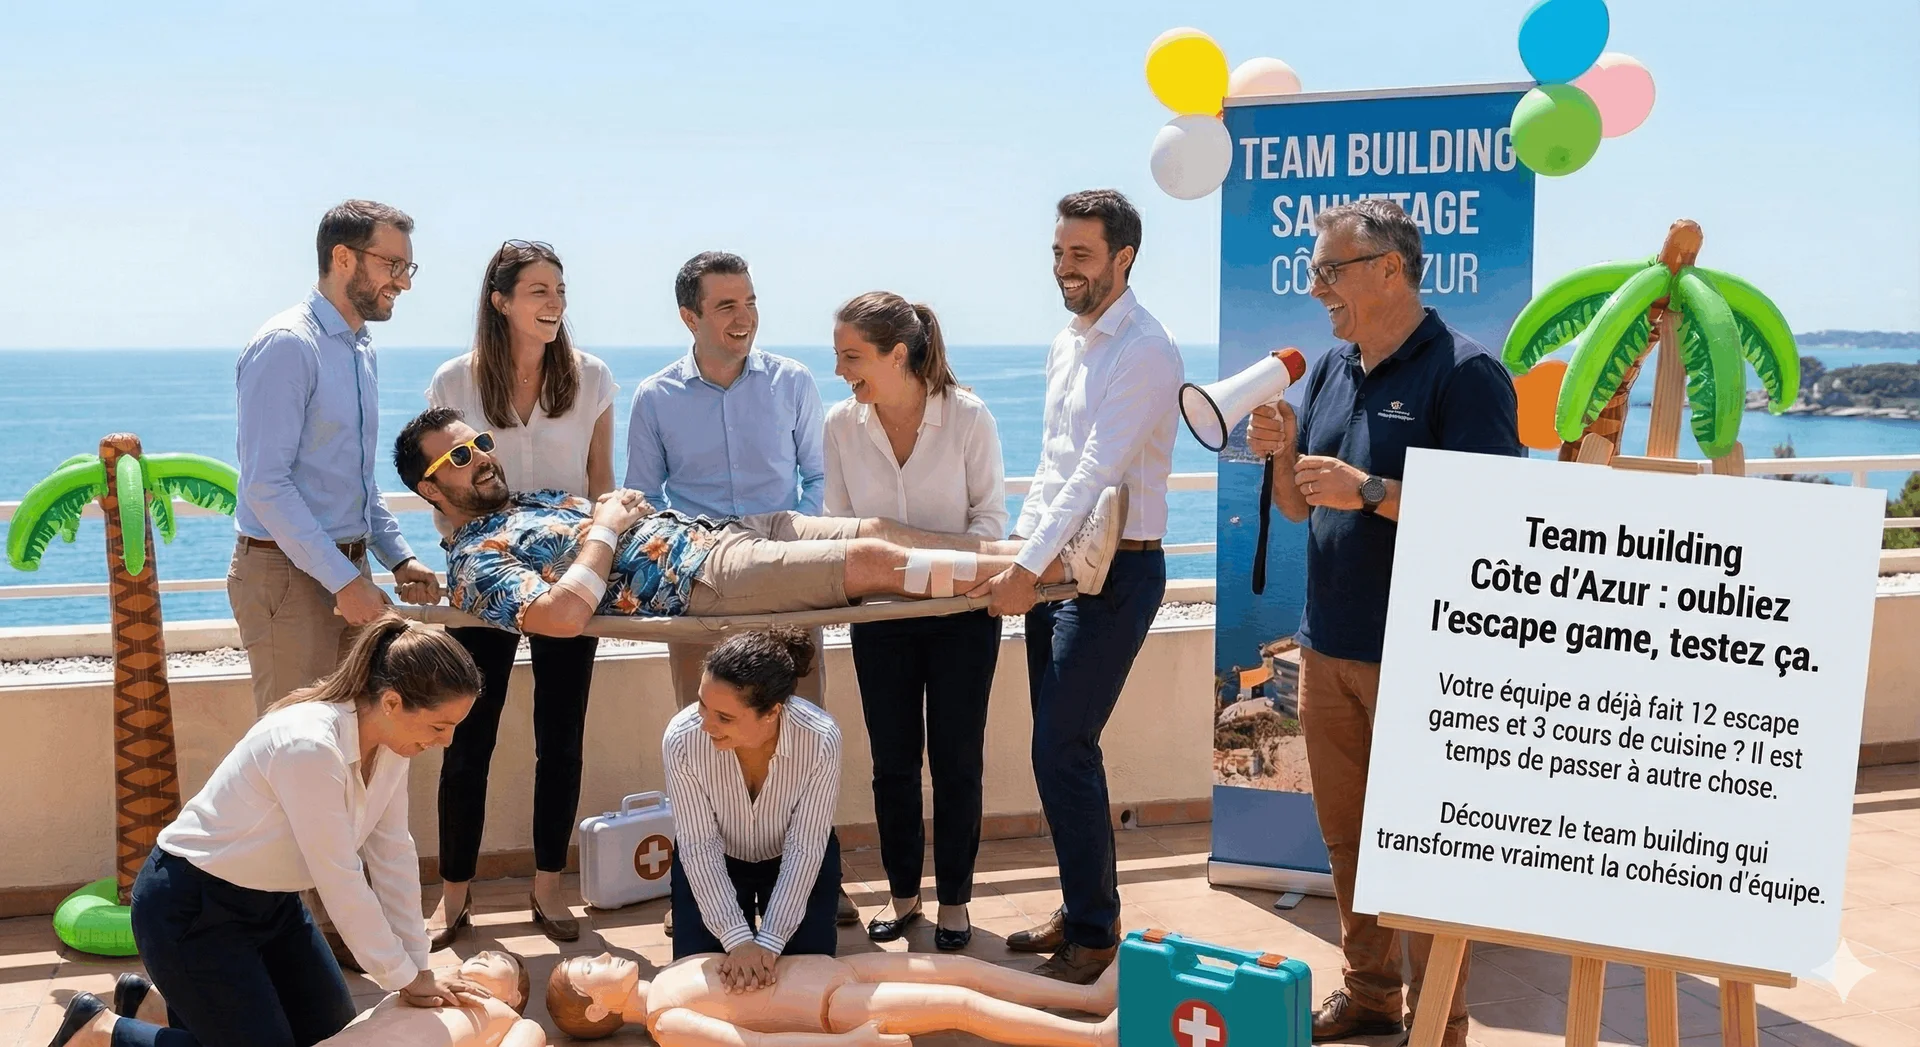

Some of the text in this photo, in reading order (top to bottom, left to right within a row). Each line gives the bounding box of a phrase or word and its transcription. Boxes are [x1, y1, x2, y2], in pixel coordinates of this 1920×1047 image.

[1239, 127, 1517, 180] TEAM BUILDING
[1525, 516, 1743, 577] Team building
[1470, 558, 1542, 596] Côte
[1658, 585, 1668, 609] :
[1677, 582, 1791, 623] oubliez
[1565, 622, 1659, 661] game,
[1669, 628, 1766, 667] testez
[1774, 645, 1819, 678] ça.
[1438, 671, 1800, 739] Votre équipe a déjà fait 12 escape
[1428, 709, 1803, 770] games et 3 cours de cuisine ? Il est
[1445, 739, 1777, 800] temps de passer à autre chose.
[1376, 827, 1495, 862] transforme
[1500, 844, 1595, 876] vraiment
[1600, 852, 1619, 879] la
[1625, 859, 1723, 891] cohésion
[1440, 801, 1769, 867] Découvrez le team building qui
